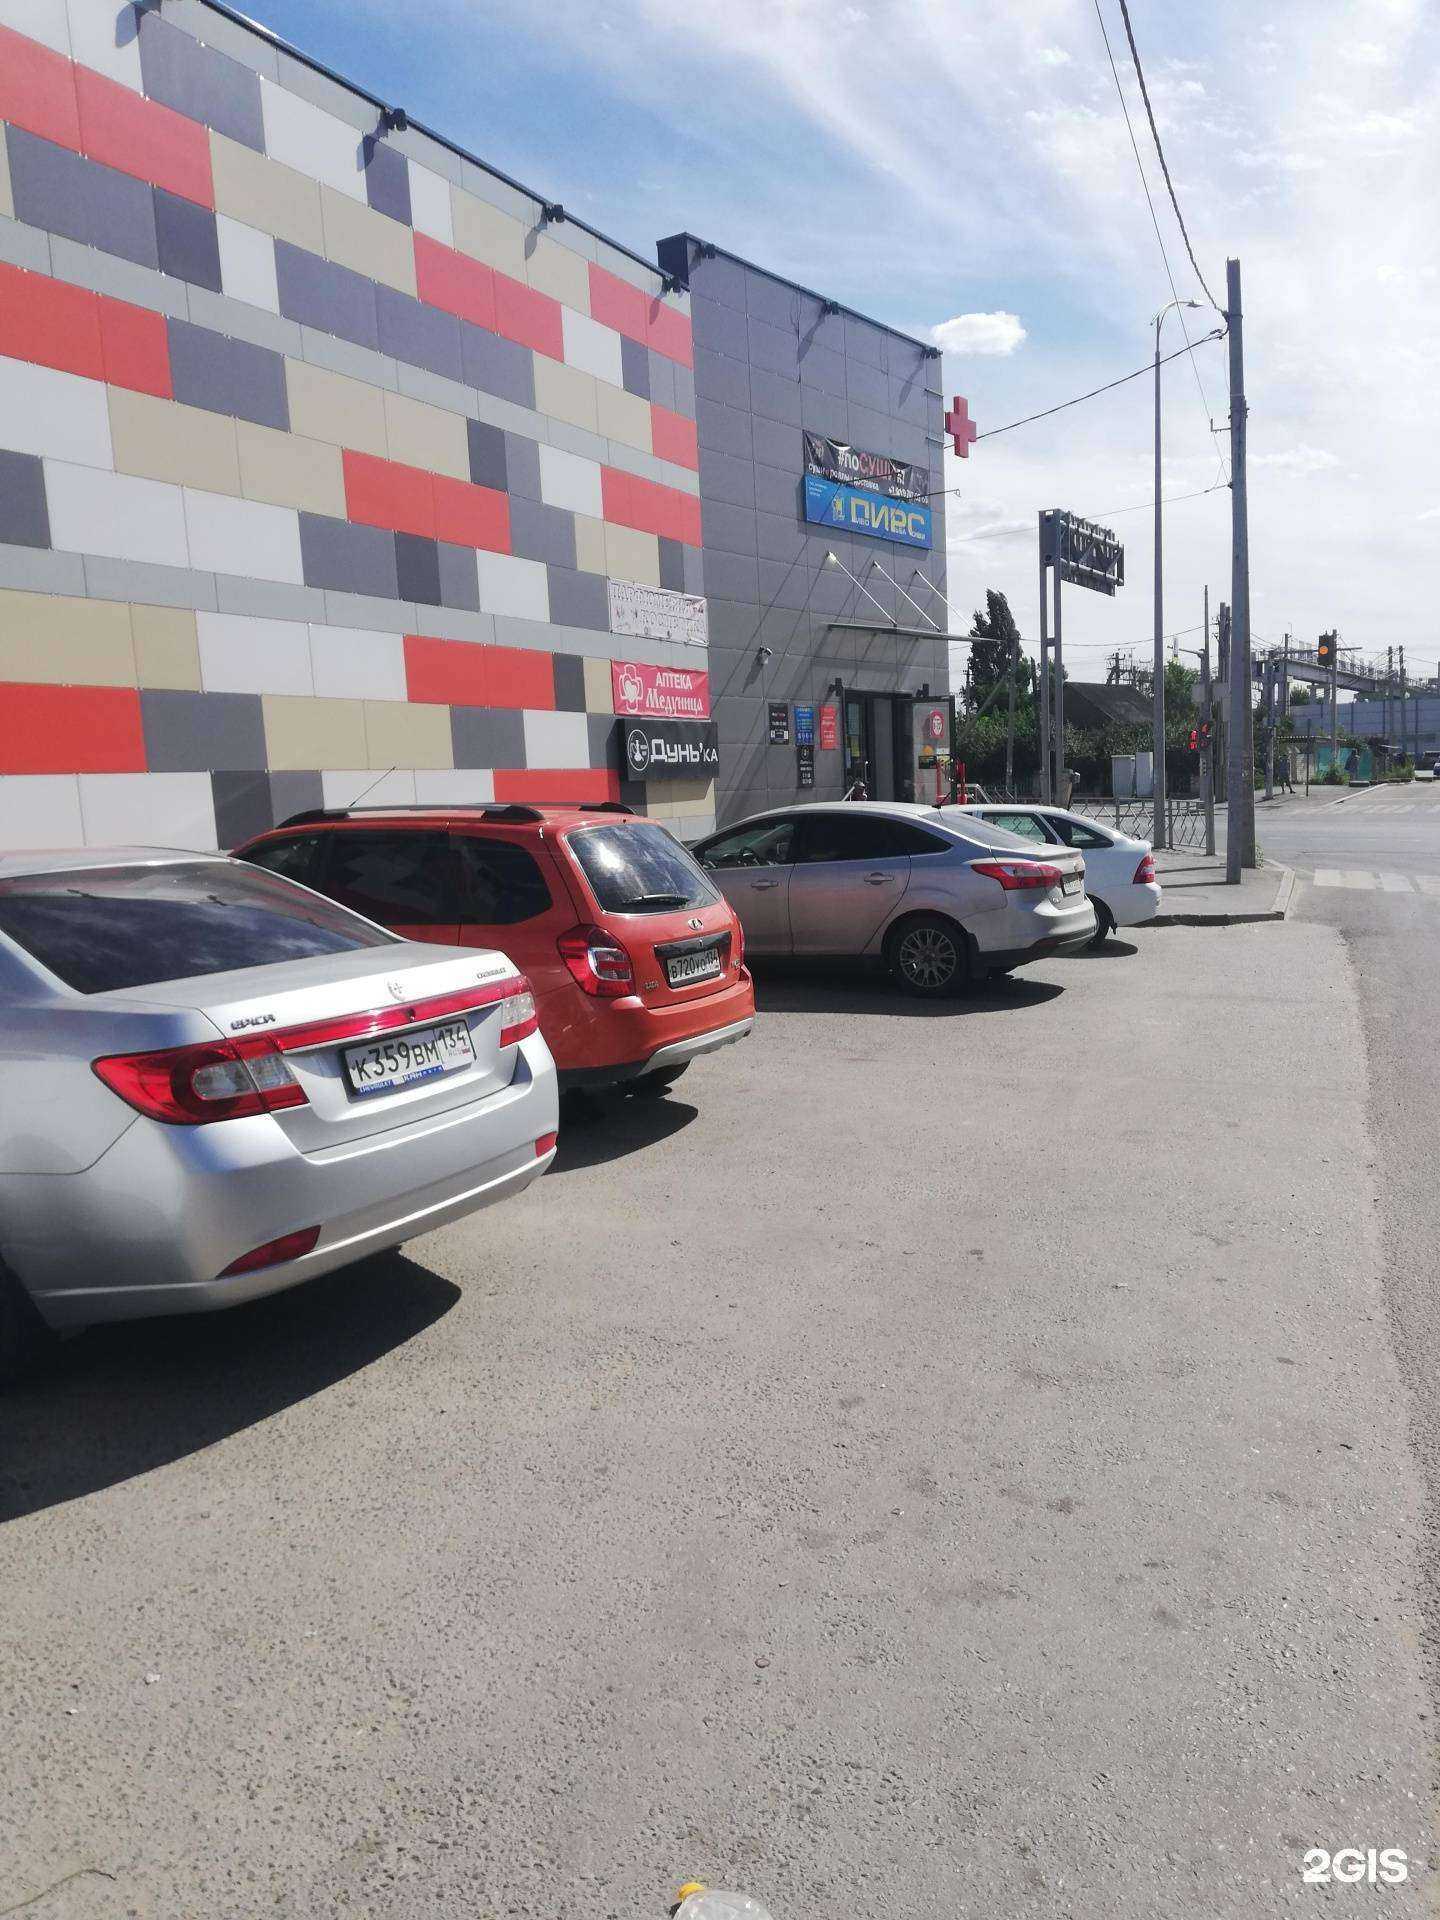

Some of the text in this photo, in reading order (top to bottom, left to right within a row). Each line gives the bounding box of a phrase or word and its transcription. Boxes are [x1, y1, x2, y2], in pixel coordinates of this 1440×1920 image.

[655, 672, 693, 690] АПТЕКА
[646, 688, 704, 715] Медуница
[355, 1025, 469, 1081] К359ВМ 134
